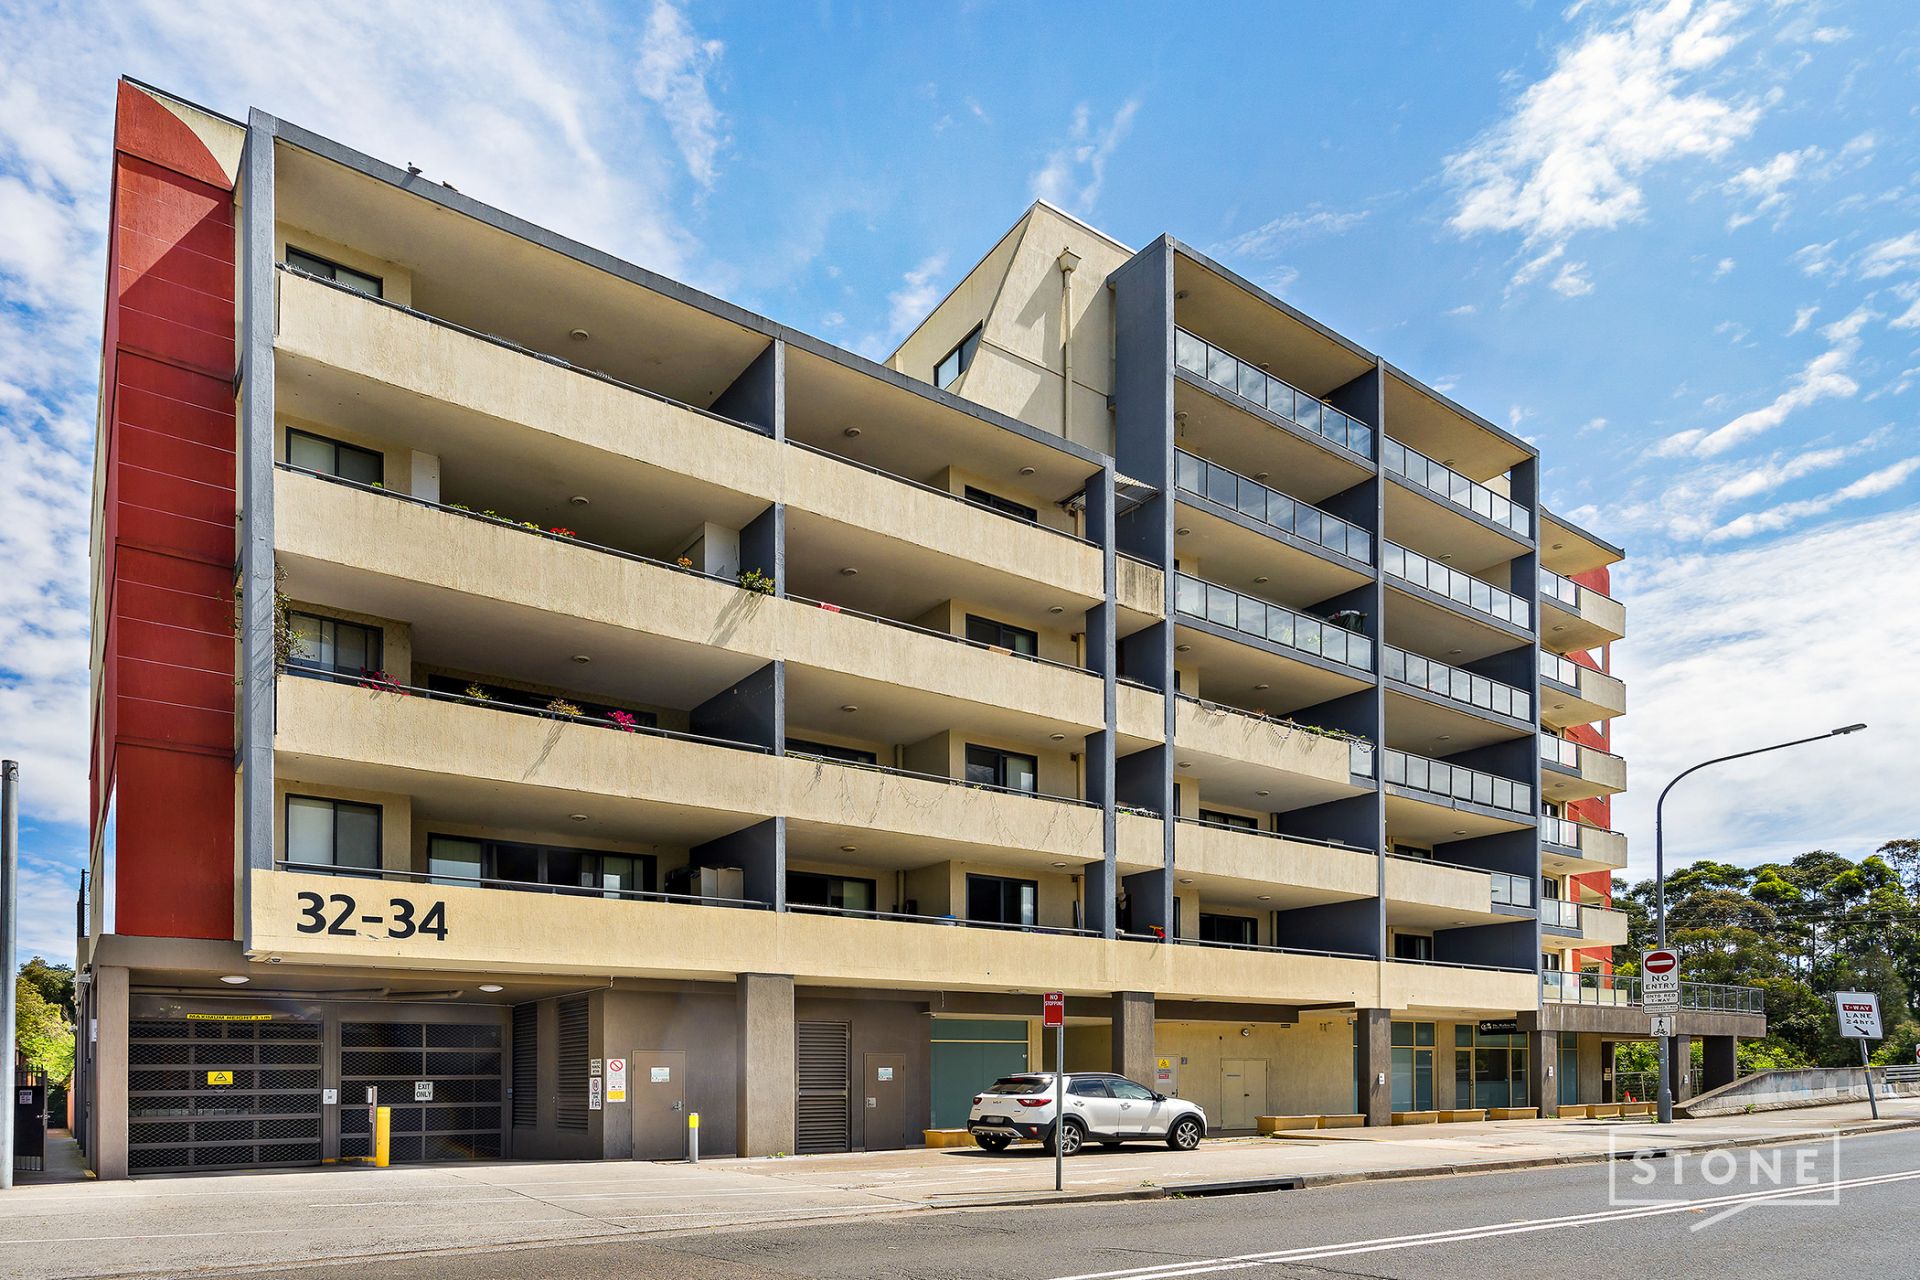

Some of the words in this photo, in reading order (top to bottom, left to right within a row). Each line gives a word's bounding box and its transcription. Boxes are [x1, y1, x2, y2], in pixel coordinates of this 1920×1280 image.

[296, 891, 449, 941] 32-34
[1651, 974, 1670, 982] NO
[1645, 982, 1676, 990] ENTRY
[415, 1090, 432, 1098] ONLY
